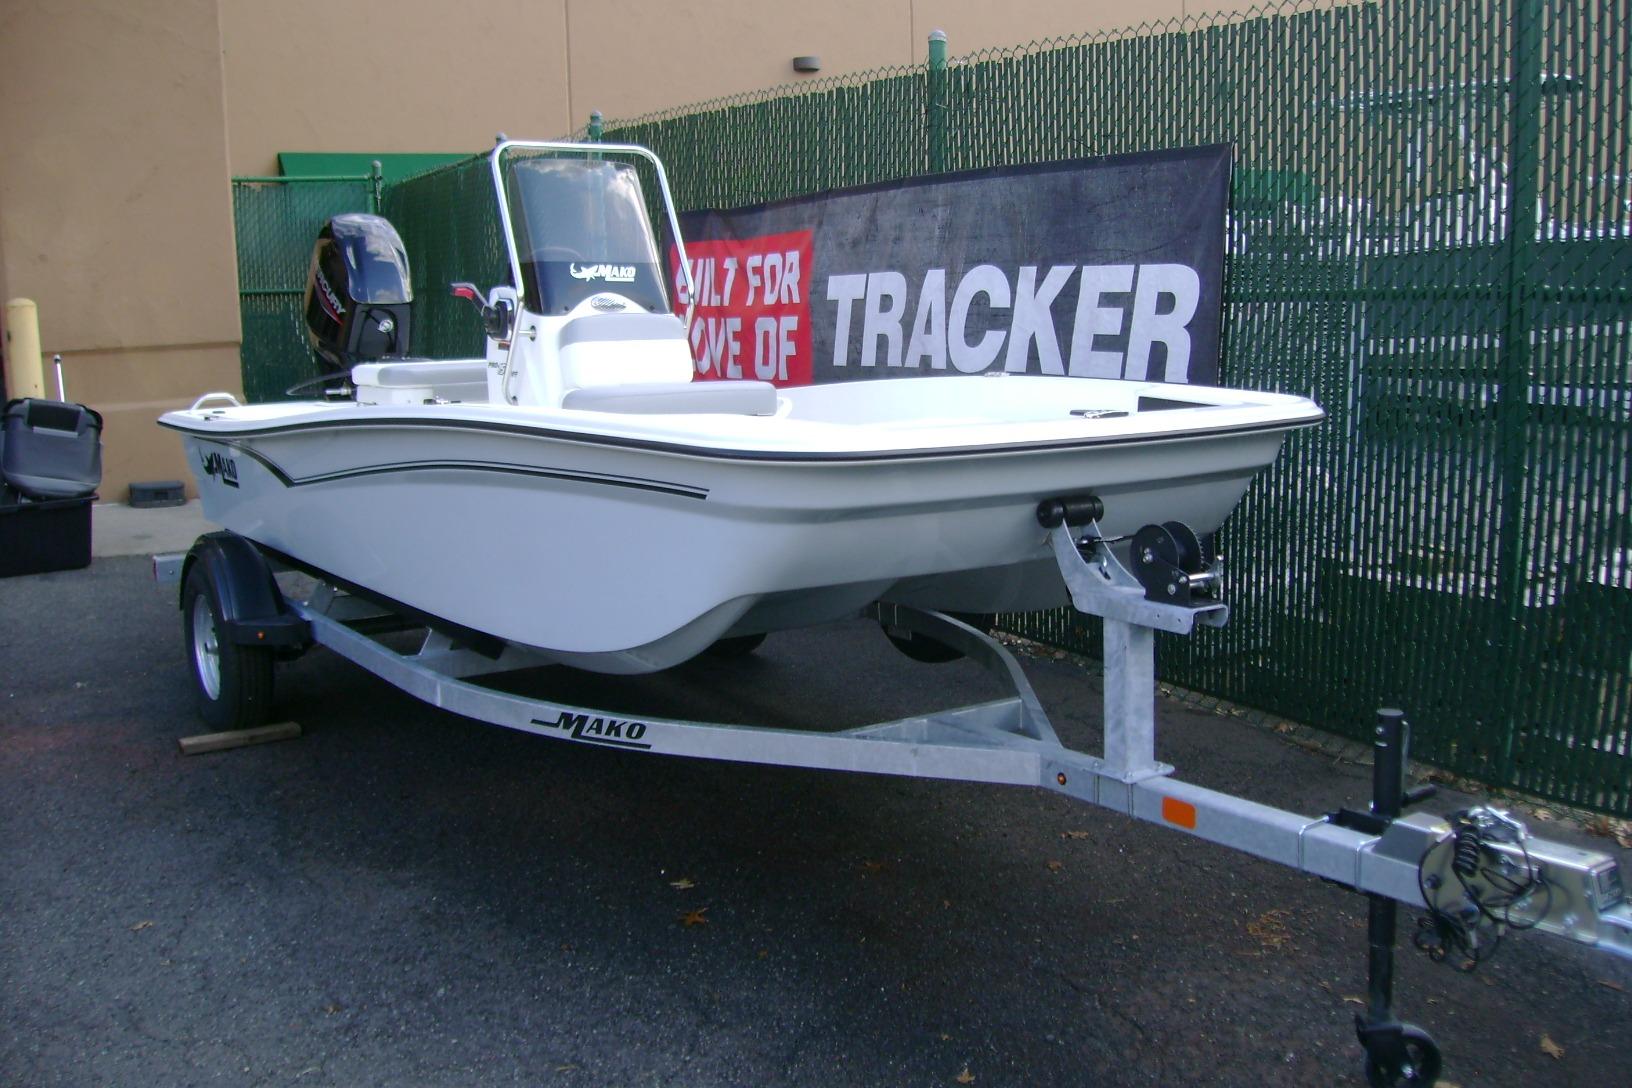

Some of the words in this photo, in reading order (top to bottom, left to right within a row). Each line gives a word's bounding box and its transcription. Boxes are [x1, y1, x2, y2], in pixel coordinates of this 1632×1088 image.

[594, 264, 636, 282] MAKO
[746, 250, 801, 306] FOR
[680, 314, 743, 379] OVE
[754, 316, 799, 380] OF
[827, 263, 1201, 384] TRACKER
[212, 452, 240, 489] MAKO
[530, 711, 652, 750] MAKO
